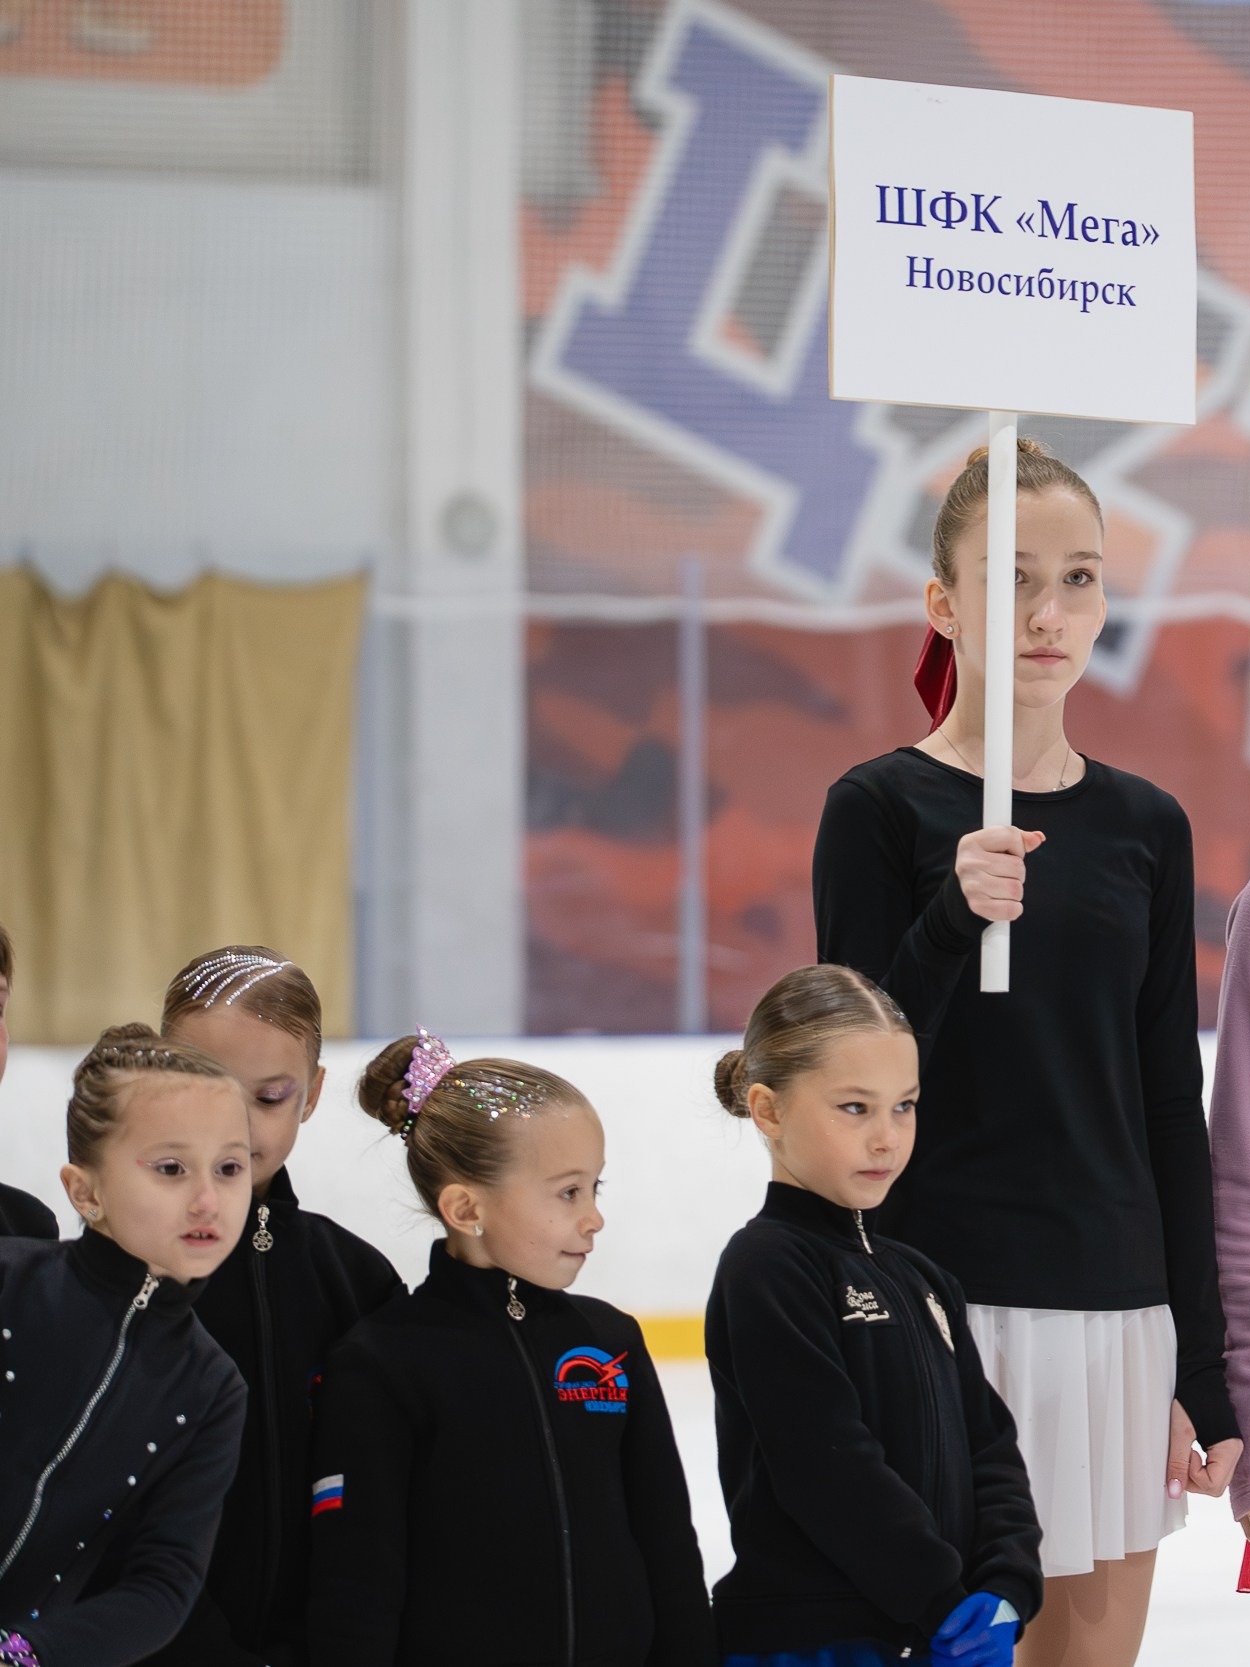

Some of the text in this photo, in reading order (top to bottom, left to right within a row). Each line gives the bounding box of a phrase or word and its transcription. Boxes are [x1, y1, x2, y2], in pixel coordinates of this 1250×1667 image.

[874, 184, 1161, 247] ШФК «Мега»
[905, 255, 1137, 314] Новосибирск
[557, 1387, 628, 1402] ЭНЕРГИЯ
